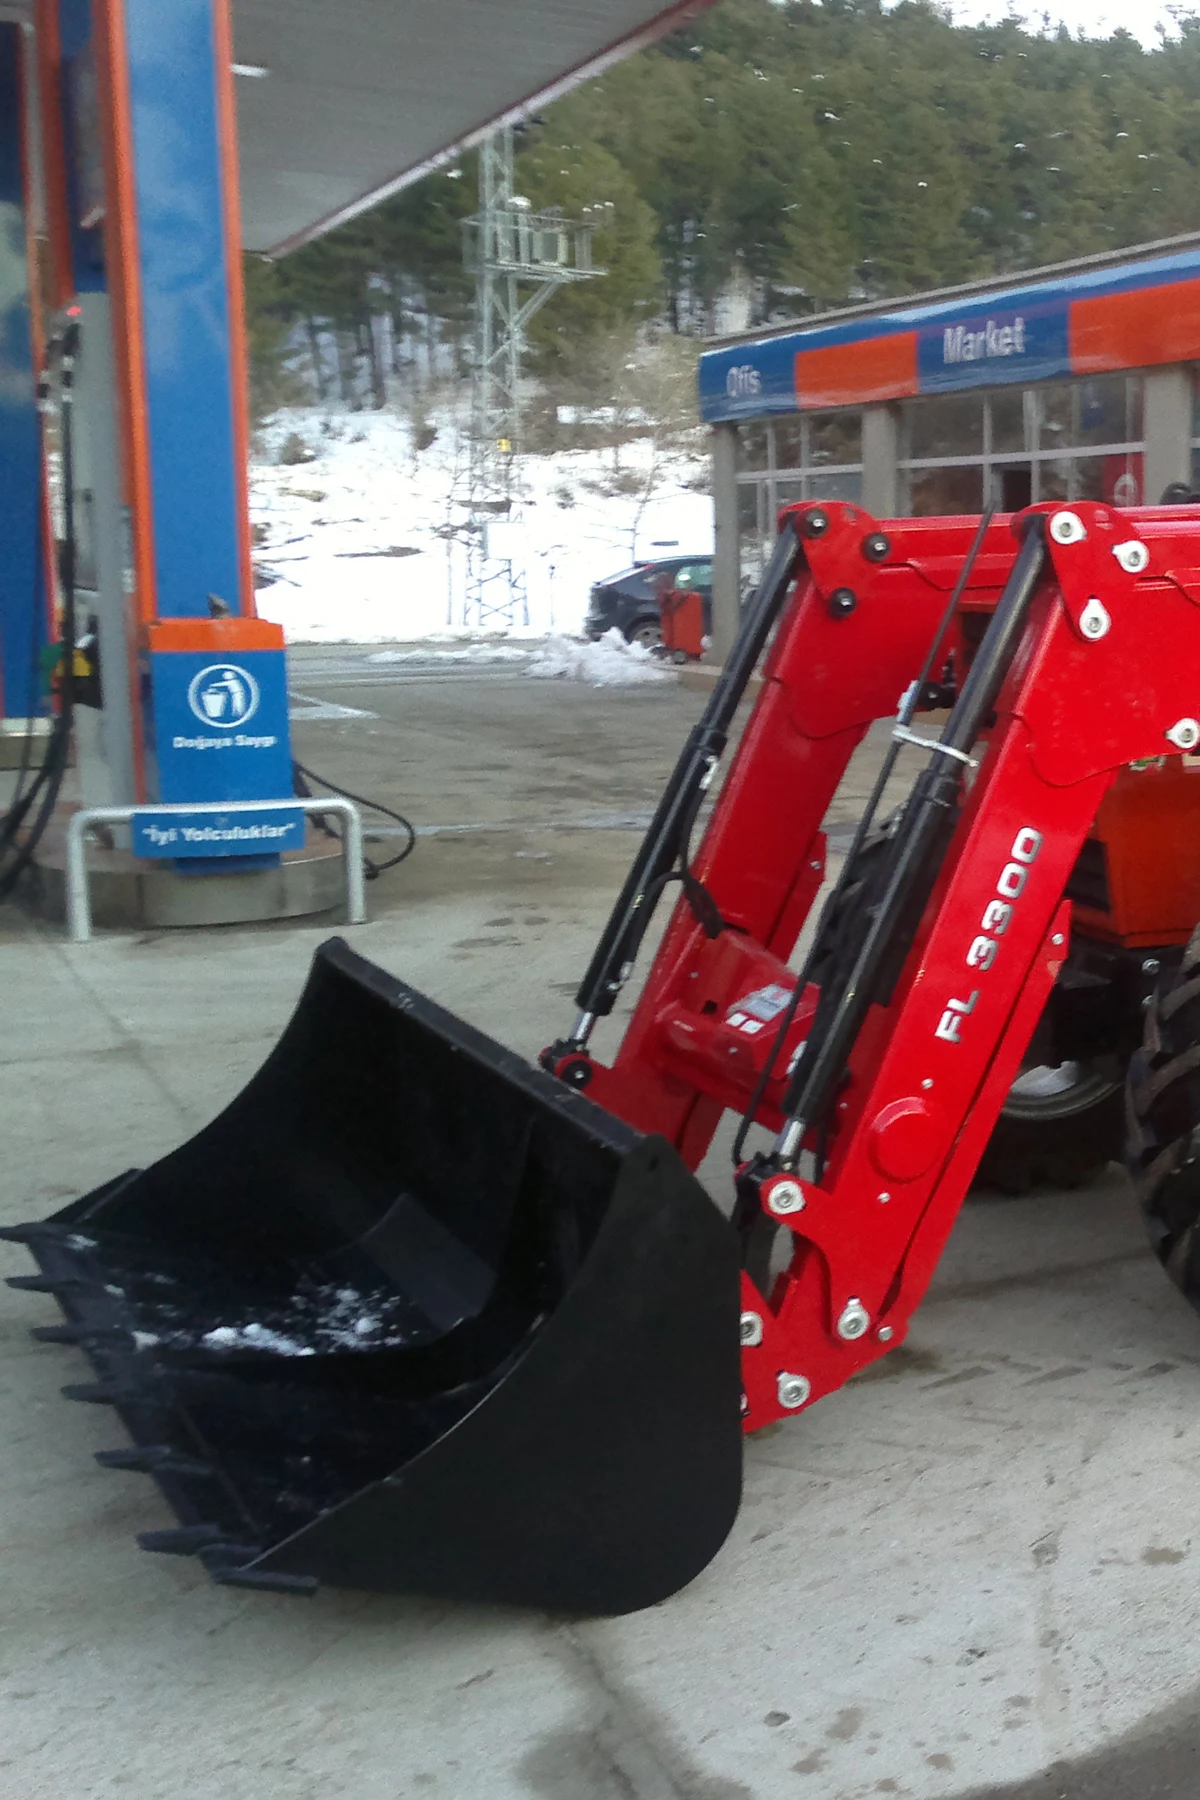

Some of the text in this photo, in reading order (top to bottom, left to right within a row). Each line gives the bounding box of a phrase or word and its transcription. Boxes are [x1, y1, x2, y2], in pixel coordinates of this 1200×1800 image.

[943, 317, 1025, 363] Market
[726, 364, 762, 397] Ofis
[934, 826, 1043, 1044] FL 3300
